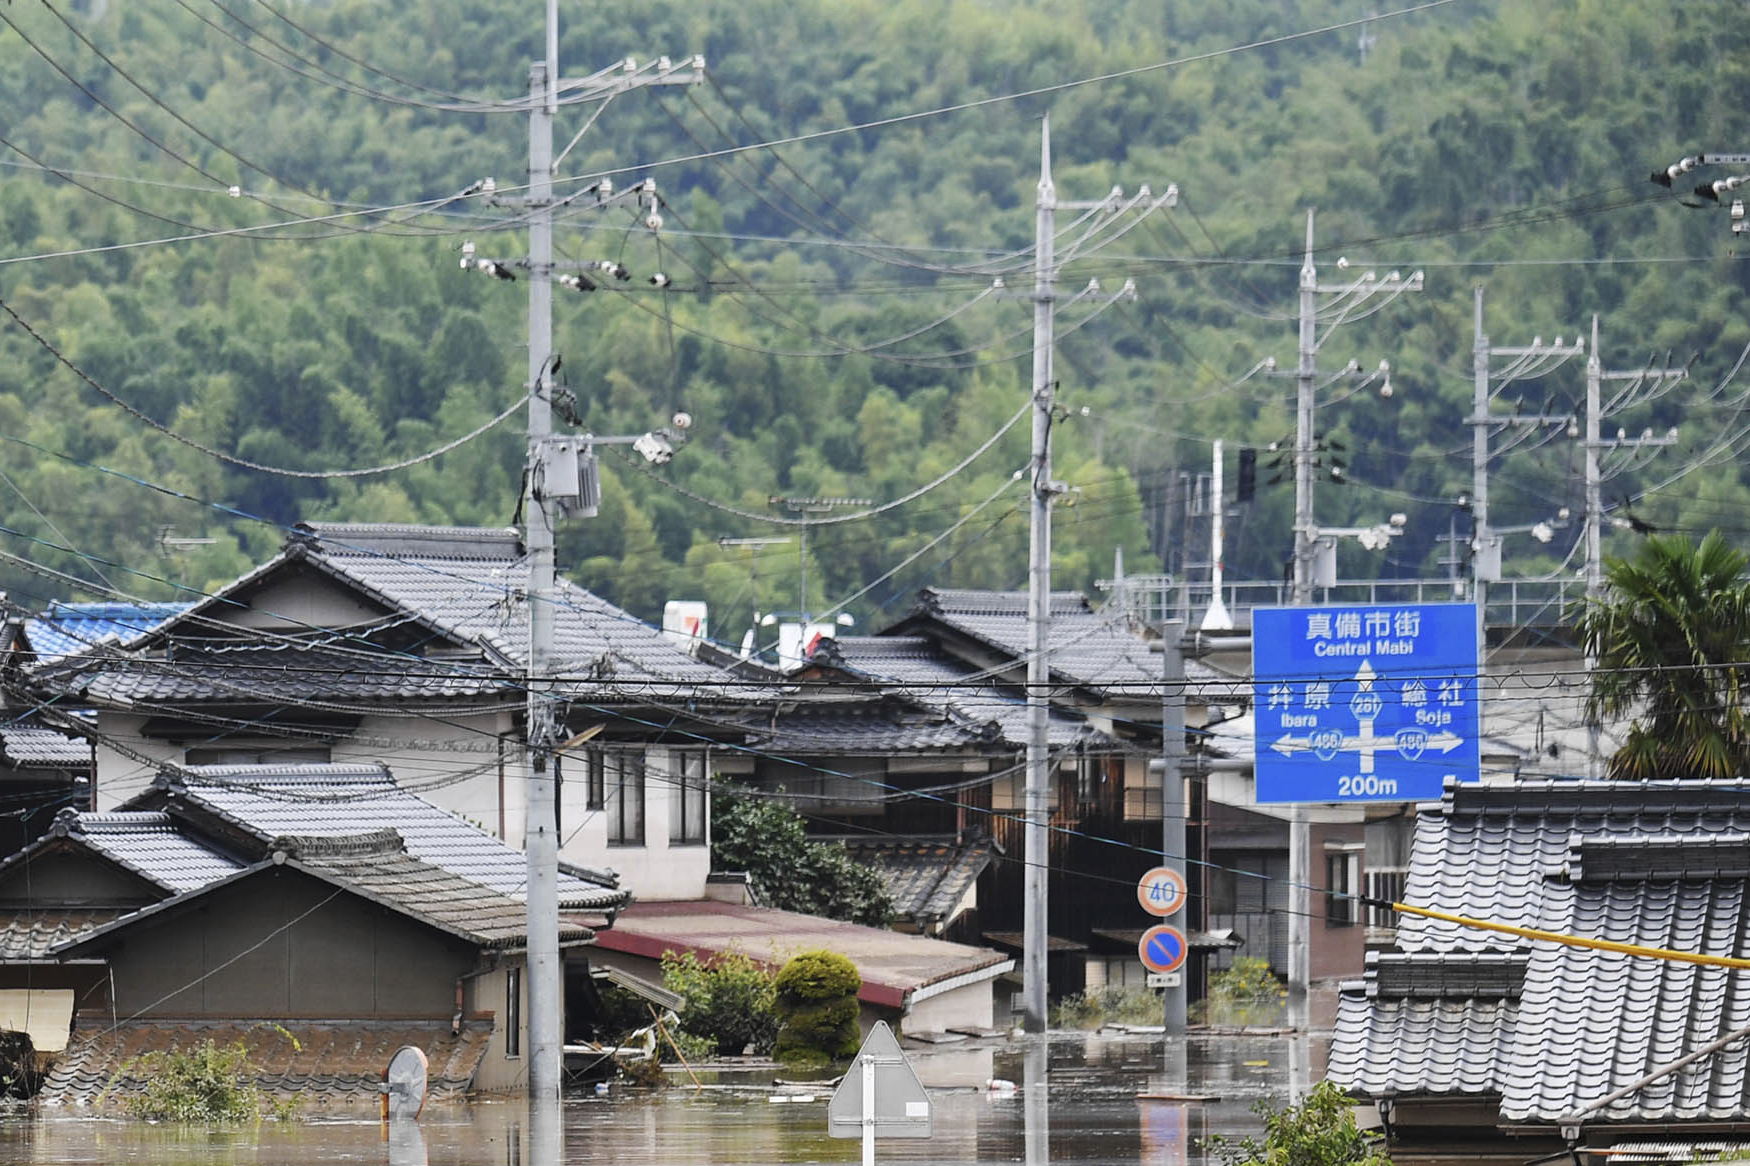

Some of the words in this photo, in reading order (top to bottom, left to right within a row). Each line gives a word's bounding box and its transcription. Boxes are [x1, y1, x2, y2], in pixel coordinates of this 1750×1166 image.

[1306, 611, 1421, 640] 真備市街
[1314, 640, 1371, 657] Central
[1376, 639, 1413, 656] Mabi
[1268, 681, 1331, 711] 井原
[1281, 712, 1318, 728] Ibara
[1415, 708, 1452, 728] Soja
[1338, 776, 1397, 796] 200m
[1149, 882, 1175, 902] 40
